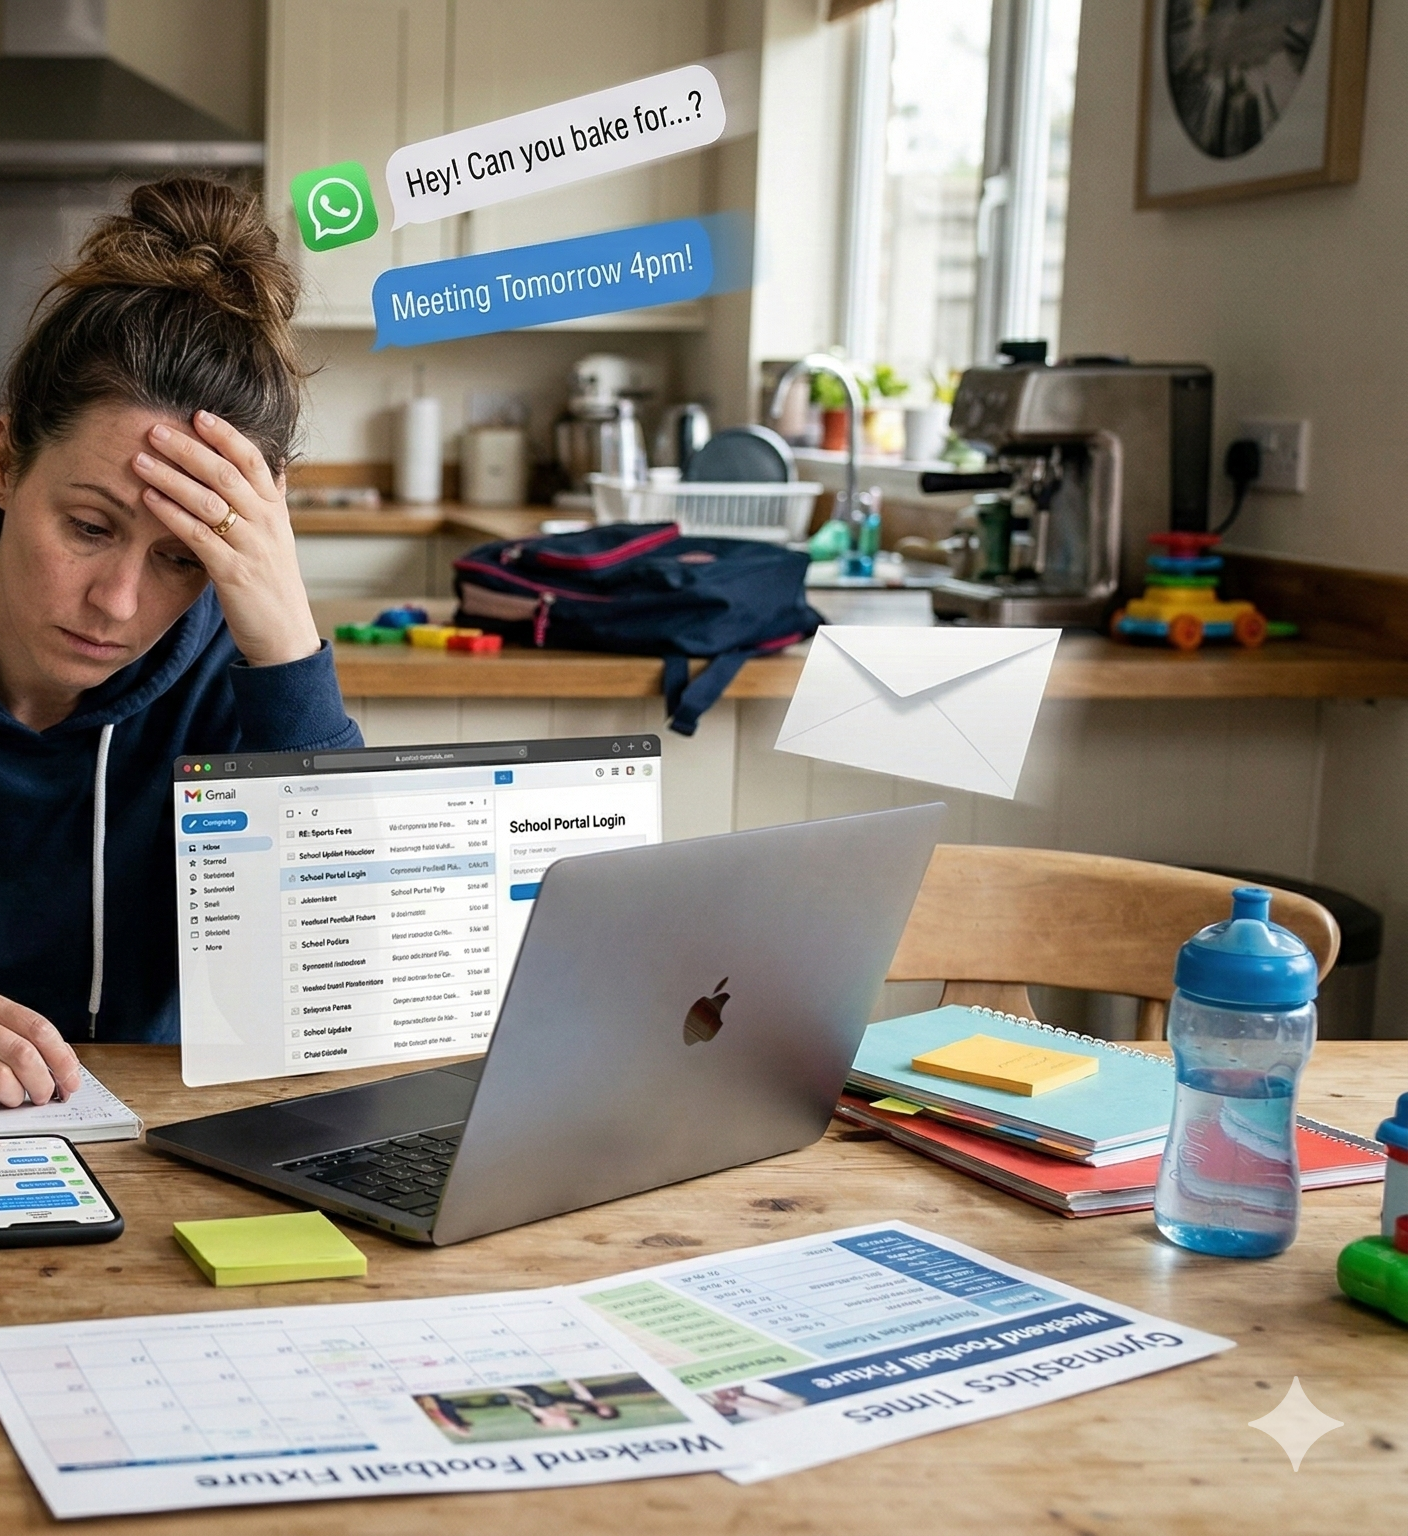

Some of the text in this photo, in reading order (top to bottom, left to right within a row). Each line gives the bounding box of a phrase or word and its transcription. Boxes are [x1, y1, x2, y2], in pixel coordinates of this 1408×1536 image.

[205, 788, 236, 802] Gmail
[509, 813, 626, 834] School Portal Login
[205, 944, 223, 952] More
[999, 1308, 1109, 1346] Weekend
[897, 1332, 999, 1370] Football
[964, 1330, 1184, 1399] Gymnastics
[810, 1358, 904, 1392] Fixture
[841, 1388, 975, 1428] Times
[194, 1465, 341, 1490] Fixture
[348, 1455, 525, 1483] Football
